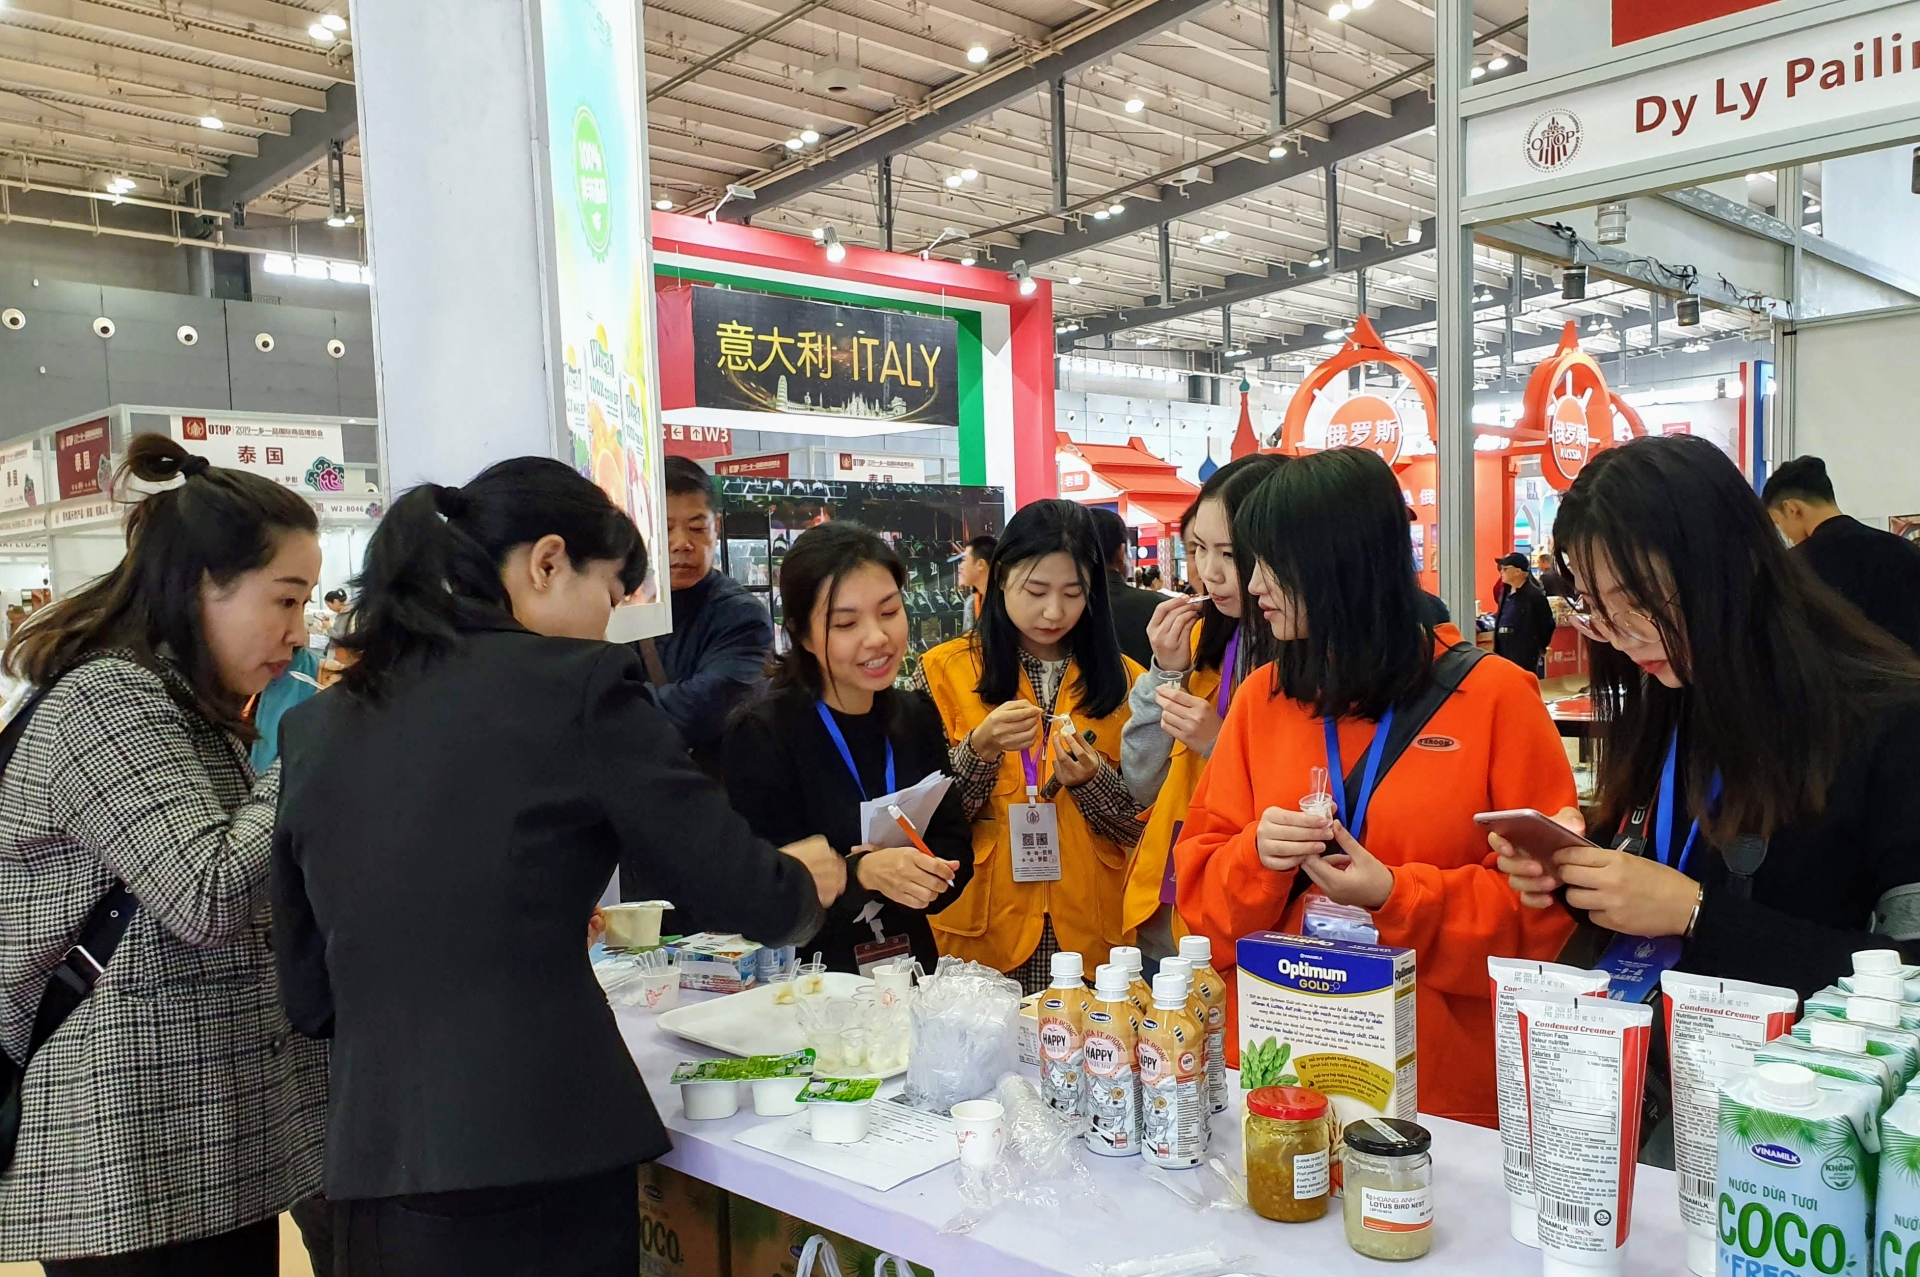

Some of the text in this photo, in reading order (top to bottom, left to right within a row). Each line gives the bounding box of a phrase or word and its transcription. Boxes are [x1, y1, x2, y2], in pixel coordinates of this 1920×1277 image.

[1636, 94, 1698, 136] Dy
[1715, 76, 1767, 121] Ly
[1531, 130, 1575, 151] OTOP
[716, 319, 941, 389] 意大利 ITALY
[208, 424, 231, 436] OTOP
[704, 426, 729, 443] W3
[1329, 419, 1399, 448] 俄罗斯
[238, 445, 284, 465] 泰国
[1278, 958, 1348, 983] Optimum
[1299, 979, 1330, 992] GOLD
[1676, 1012, 1698, 1020] Nutrition
[1680, 1003, 1760, 1020] Condensed Creamer
[1534, 1020, 1616, 1036] Condensed Creamer
[1692, 1020, 1714, 1029] nutritive
[1042, 1032, 1066, 1047] HAPPY
[1674, 1030, 1696, 1040] Calories
[1085, 1046, 1113, 1062] HAPPY
[1532, 1050, 1551, 1058] Calories
[1754, 1145, 1800, 1164] VINAMILK
[1826, 1162, 1854, 1172] KHÔNG
[1728, 1176, 1818, 1212] NƯỚC DỪA TƯƠI
[1370, 1200, 1392, 1210] LOTUS
[1411, 1200, 1425, 1208] NEST
[1718, 1192, 1847, 1275] COCO
